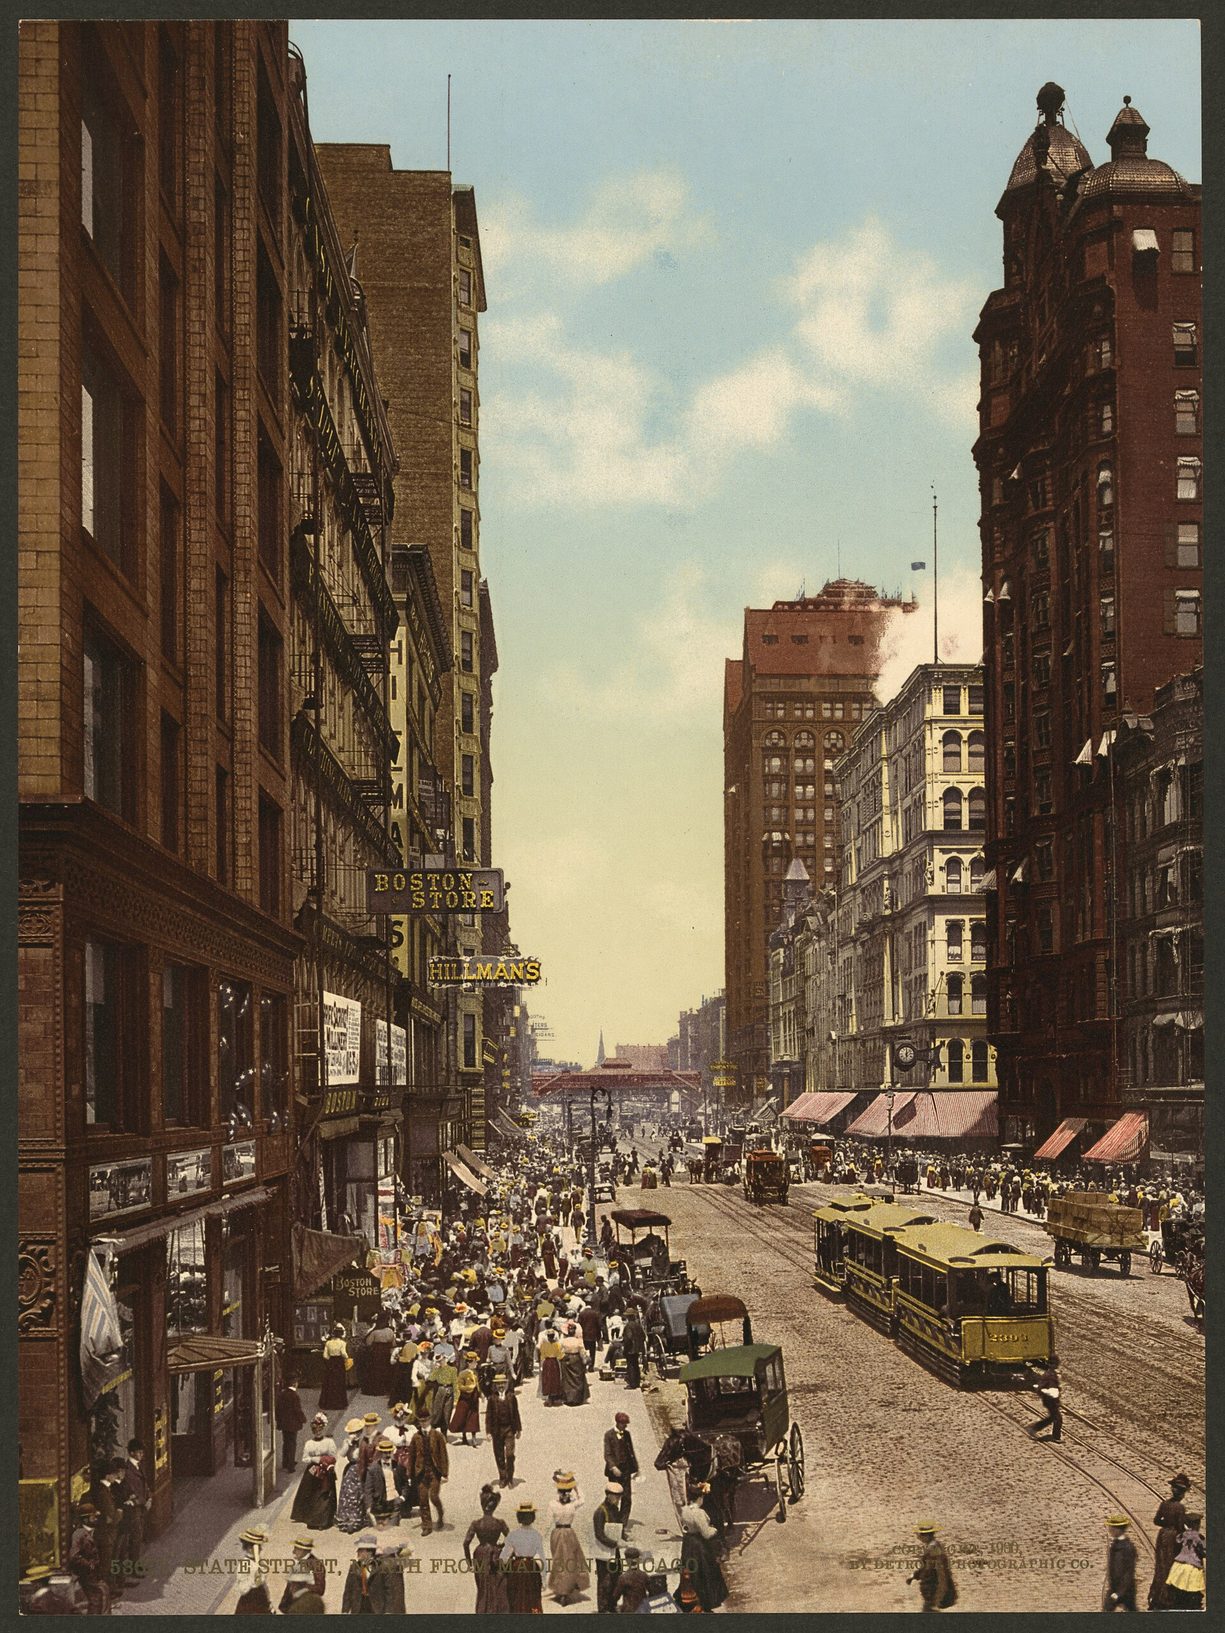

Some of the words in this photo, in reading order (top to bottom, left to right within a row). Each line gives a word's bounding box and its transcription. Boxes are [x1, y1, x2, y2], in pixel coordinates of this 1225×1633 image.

[375, 873, 473, 892] BOSTON
[412, 890, 495, 909] STORE
[429, 961, 541, 981] HILLMAN'S
[348, 1287, 380, 1298] STORE
